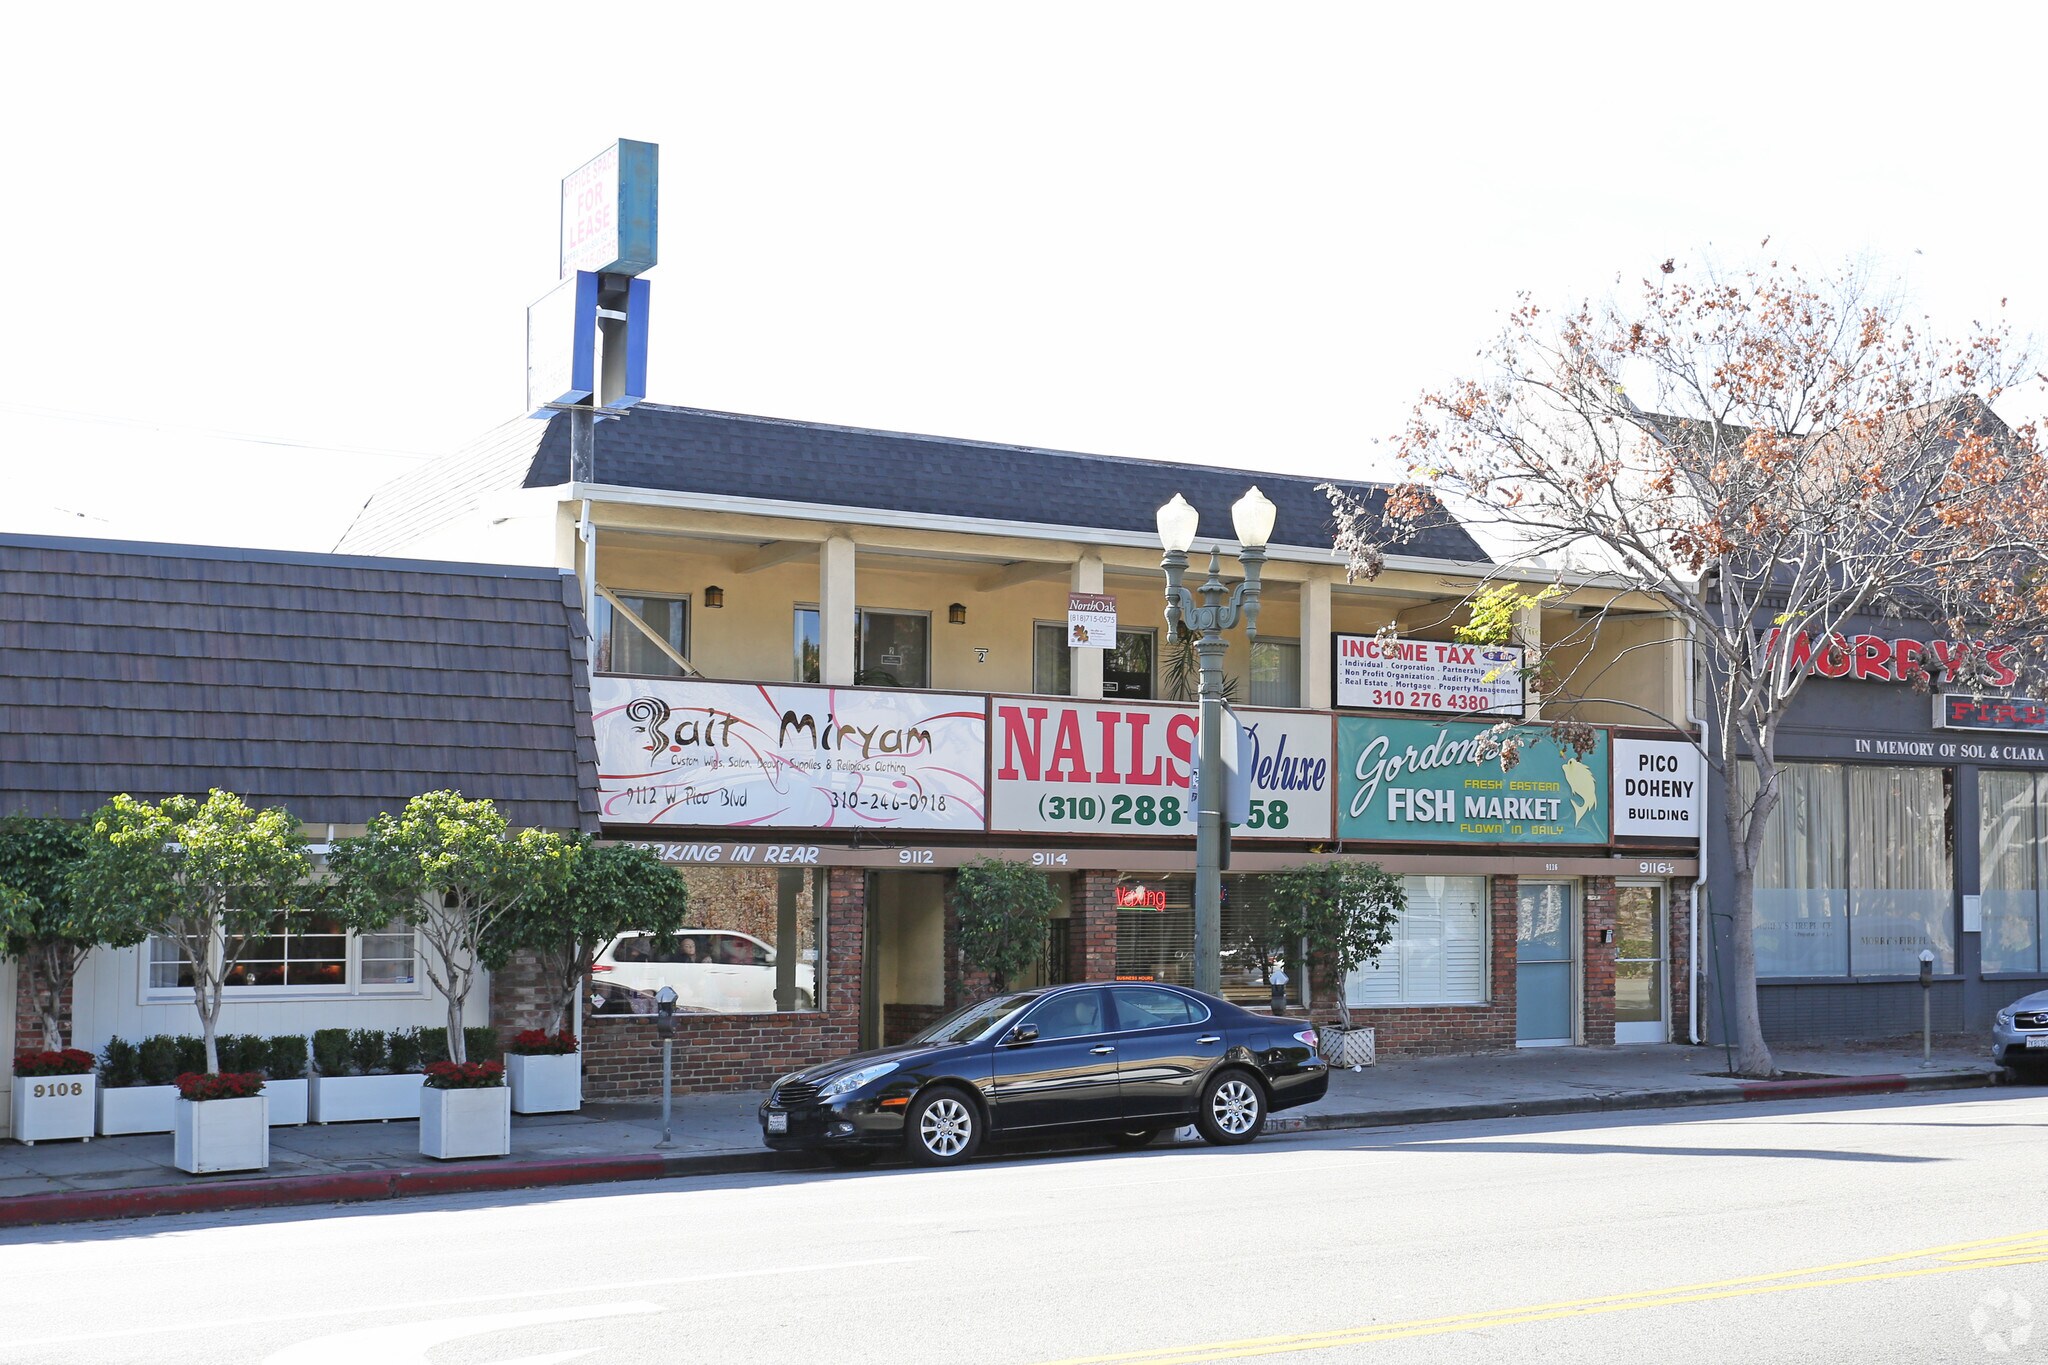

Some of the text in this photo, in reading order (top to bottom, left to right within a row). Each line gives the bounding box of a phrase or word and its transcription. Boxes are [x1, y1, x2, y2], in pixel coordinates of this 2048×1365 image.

[577, 181, 603, 216] FOR
[570, 203, 610, 249] LEASE
[1069, 600, 1115, 612] NorthOak
[978, 653, 985, 663] 2
[1435, 645, 1476, 665] TAX
[1767, 627, 2019, 687] MORRY'S
[1345, 660, 1486, 676] Individual Corporation Partnership
[1362, 670, 1384, 678] Profit
[1387, 671, 1435, 681] Organization
[1442, 674, 1462, 682] Audit
[1364, 679, 1388, 687] Estate
[1396, 681, 1431, 691] Mortgage
[1439, 683, 1471, 693] Property
[1473, 686, 1519, 695] Management
[1372, 690, 1488, 711] 310 276 4380
[1952, 702, 2047, 724] FIRE
[779, 710, 932, 759] Miryam
[998, 706, 1200, 789] NAILS
[1855, 739, 2045, 761] IN MEMORY OF SOL & CLARA
[671, 755, 699, 766] Custom
[758, 758, 784, 771] Beauty
[789, 758, 822, 770] Supplies
[826, 759, 832, 770] &
[837, 759, 870, 773] Religious
[875, 761, 906, 775] Clothing
[1639, 754, 1678, 773] PICO
[1464, 779, 1560, 791] FRESH EASTERN
[1625, 779, 1694, 798] DOHENY
[626, 786, 749, 808] 9112 W Pico Blvd
[831, 792, 947, 812] 310-246-0918
[1387, 787, 1561, 823] FISH MARKET
[1038, 792, 1106, 823] (310)
[1628, 808, 1689, 821] BUILDING
[1460, 823, 1564, 835] FLOWN IN DAILY
[624, 842, 820, 864] RKING IN REAR
[899, 851, 934, 863] 9112
[1032, 852, 1068, 866] 9114
[1545, 863, 1558, 871] 9116
[33, 1082, 83, 1098] 9108
